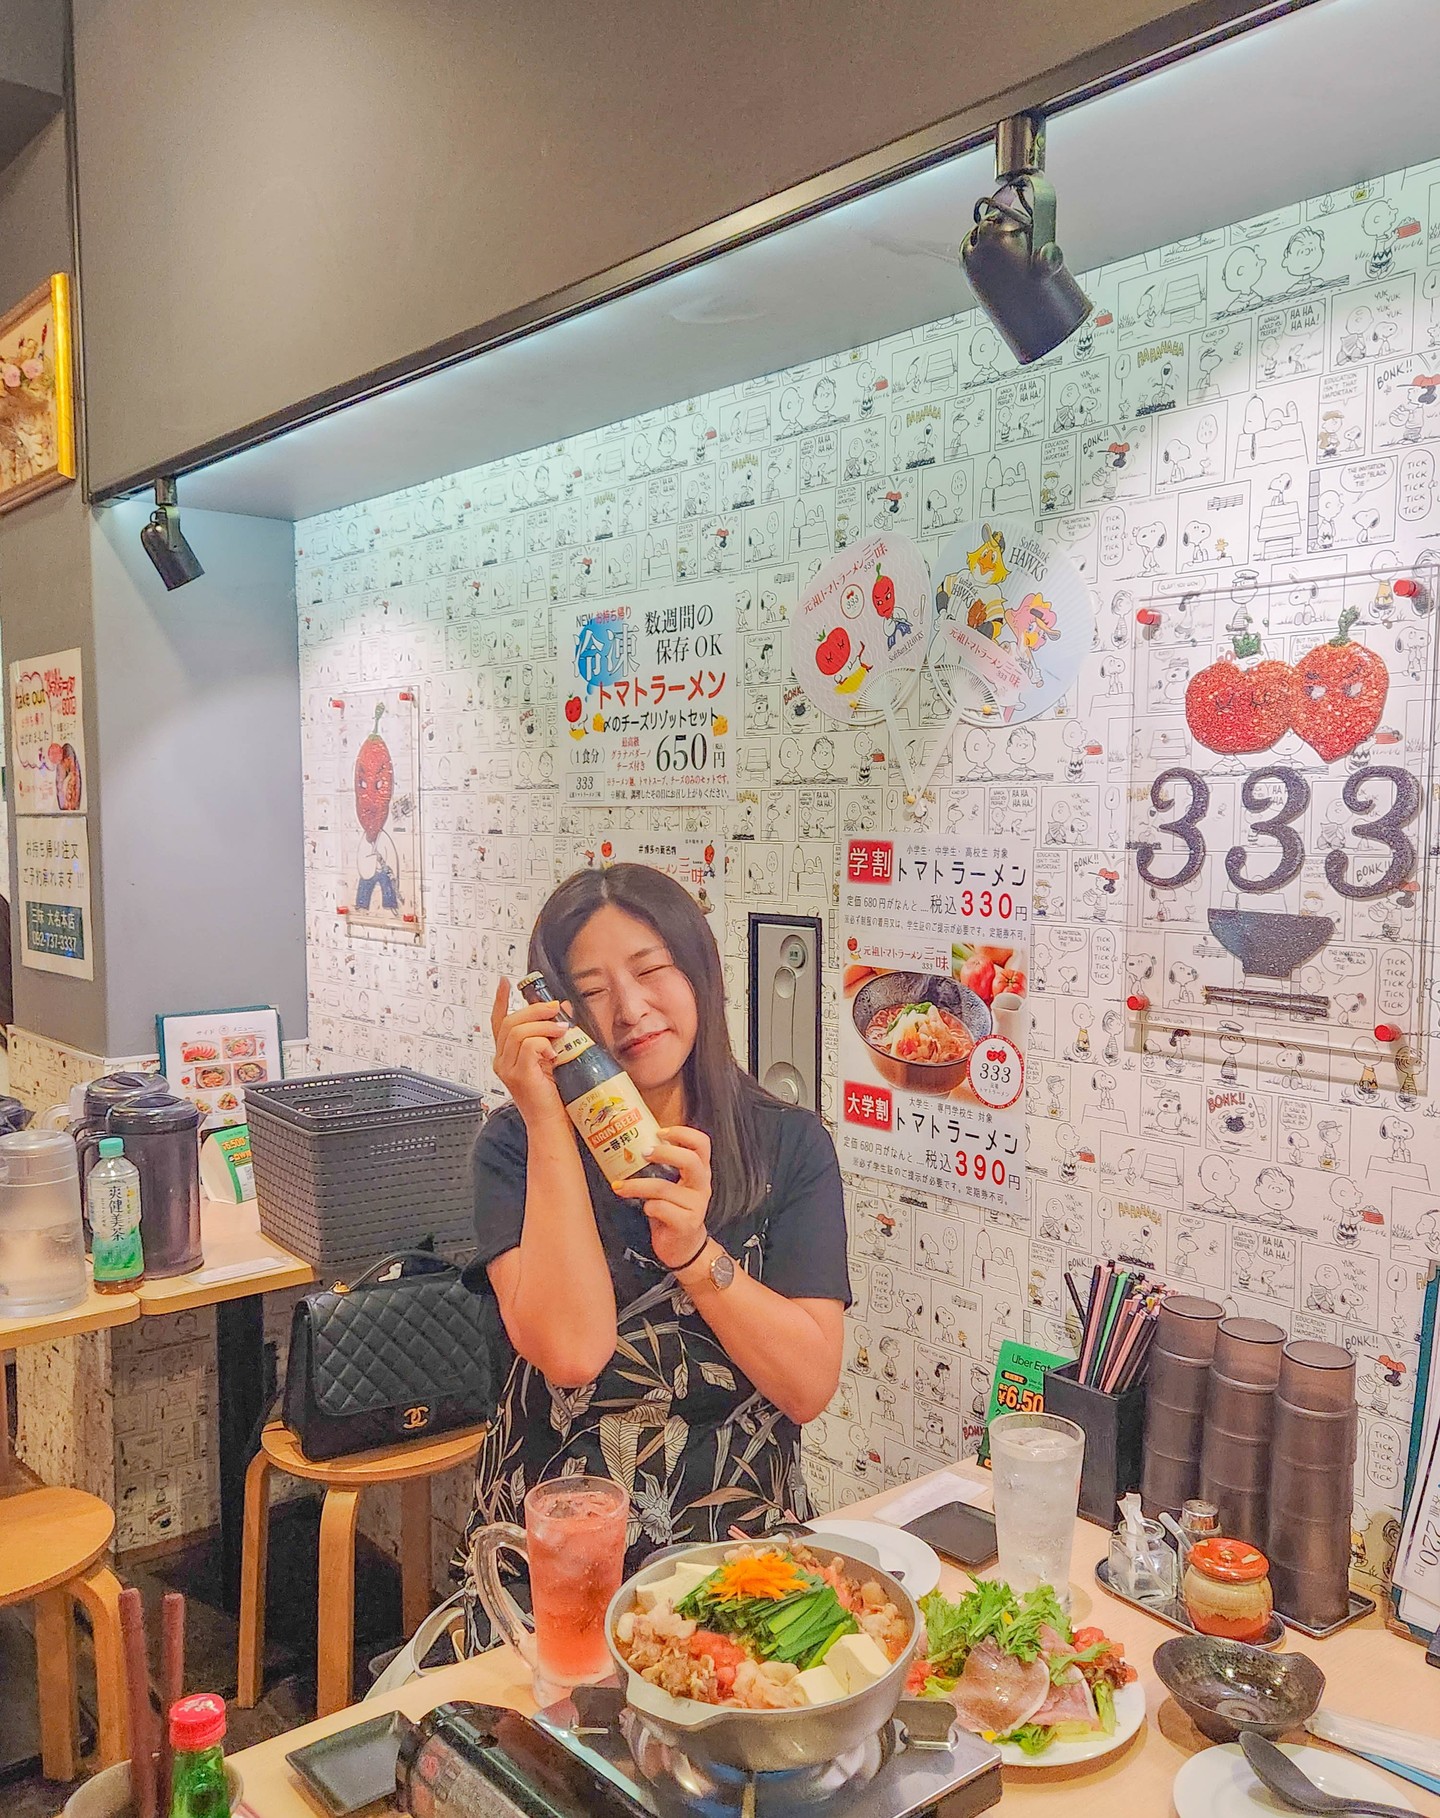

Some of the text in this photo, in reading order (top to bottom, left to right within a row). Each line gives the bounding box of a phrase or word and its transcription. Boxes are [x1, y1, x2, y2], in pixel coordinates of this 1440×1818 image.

[1374, 289, 1388, 300] YUK
[1386, 293, 1401, 302] YUK
[1290, 305, 1314, 318] HA HA
[1291, 315, 1320, 330] HA HA!
[1324, 372, 1357, 385] EDUCATION
[1377, 360, 1413, 389] BONK!!
[1342, 379, 1357, 388] THAT
[1322, 386, 1357, 399] IMPORTANT
[1083, 431, 1109, 454] BONK!!
[1407, 460, 1428, 470] TICK
[1406, 471, 1427, 480] TICK
[1403, 482, 1425, 492] TICK
[1405, 493, 1425, 503] TICK
[1403, 505, 1424, 515] TICK
[1019, 536, 1050, 563] SoftBank
[863, 559, 875, 572] 333
[1008, 547, 1048, 582] HAWKS
[847, 594, 860, 610] 333
[576, 606, 632, 627] NEW お持ち帰り
[644, 603, 714, 637] 数週間の
[571, 623, 640, 681] 冷凍
[656, 633, 723, 665] 保存 OK
[599, 670, 726, 710] トマトラーメン
[656, 732, 725, 772] 650 円
[616, 760, 645, 771] チーズ付き
[575, 776, 594, 790] 333
[1137, 766, 1421, 901] 333
[26, 839, 79, 860] お持ち帰り注文
[993, 848, 1008, 860] 対象
[849, 846, 892, 878] 学割
[1074, 854, 1099, 872] BONK!!
[898, 858, 1026, 886] トマトラーメン
[930, 894, 957, 915] 税込
[960, 890, 1012, 919] 330
[1015, 905, 1028, 922] 円
[46, 909, 75, 930] 大名本店
[1386, 957, 1406, 966] TICK
[1385, 969, 1406, 978] TICK
[1383, 979, 1404, 988] TICK
[1385, 990, 1405, 999] TICK
[1383, 1001, 1403, 1010] TICK
[558, 1037, 588, 1054] 一番搾り
[980, 1063, 1011, 1083] 333
[847, 1092, 889, 1122] 大学割
[1207, 1092, 1245, 1114] BONK!!
[978, 1112, 993, 1124] 対象
[592, 1113, 641, 1145] KIRIN BEER
[897, 1108, 1018, 1155] トマトラーメン
[603, 1127, 639, 1153] 一番搾り
[925, 1150, 952, 1173] 税込
[955, 1150, 1006, 1186] 390
[1008, 1174, 1021, 1191] 円
[109, 1185, 125, 1241] 爽健美茶
[1262, 1236, 1284, 1248] HA HA
[1263, 1248, 1290, 1261] HA HA!
[1068, 1257, 1093, 1270] BONK!!
[1341, 1260, 1355, 1268] YUK
[1343, 1273, 1357, 1282] YUK
[1352, 1267, 1367, 1276] YUK
[1353, 1283, 1369, 1292] YUK
[1295, 1315, 1327, 1328] EDUCATION
[1295, 1322, 1310, 1331] ISN'T
[1345, 1335, 1379, 1350] BONK!!
[1011, 1353, 1052, 1373] Uber Eat
[1374, 1431, 1394, 1441] TICK
[1374, 1441, 1394, 1452] TICK
[1371, 1451, 1391, 1462] TICK
[1373, 1461, 1393, 1472] TICK
[1371, 1471, 1392, 1482] TICK
[1419, 1520, 1440, 1566] 220
